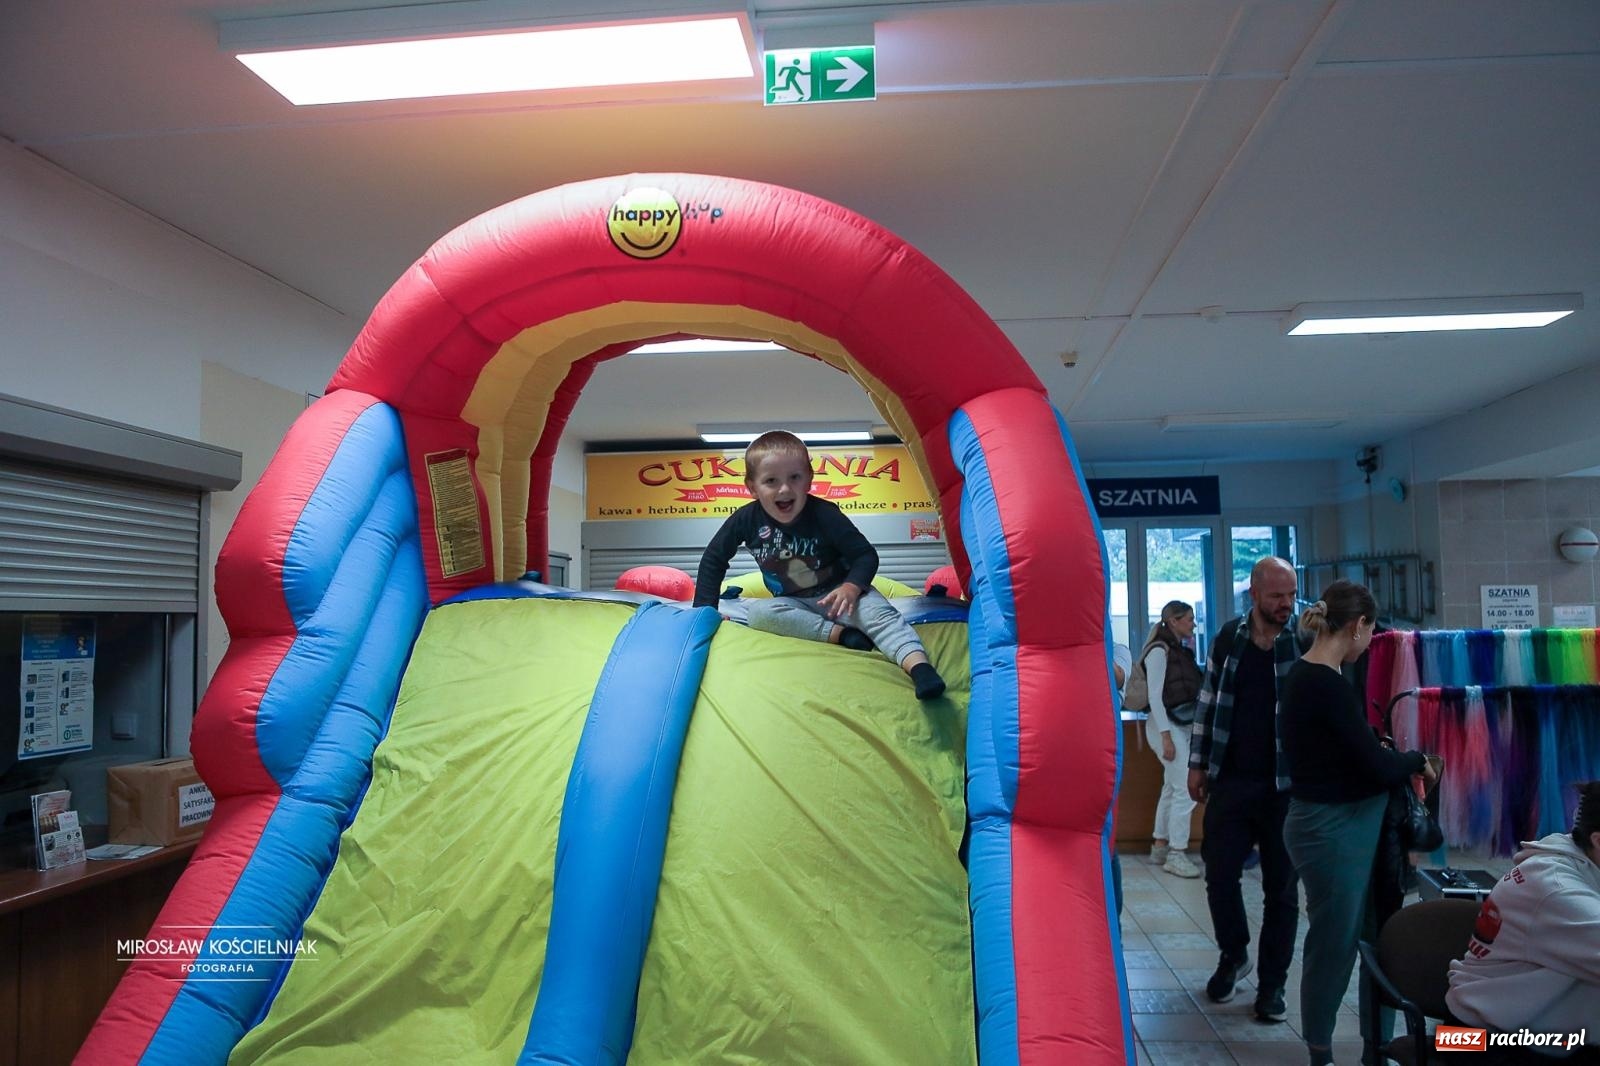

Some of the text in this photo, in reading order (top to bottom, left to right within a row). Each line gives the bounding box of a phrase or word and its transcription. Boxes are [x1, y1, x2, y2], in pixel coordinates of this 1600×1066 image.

[613, 204, 678, 226] happy
[638, 454, 900, 487] CUKNIA
[1099, 488, 1198, 506] SZATNIA
[599, 507, 632, 515] kawa
[648, 506, 697, 514] herbata
[837, 501, 887, 510] kołacze
[904, 500, 932, 510] pras
[1488, 588, 1531, 598] SZATNIA
[189, 785, 207, 795] ANKIE
[183, 797, 214, 810] SATYSFAK
[182, 809, 213, 824] PRACOWN
